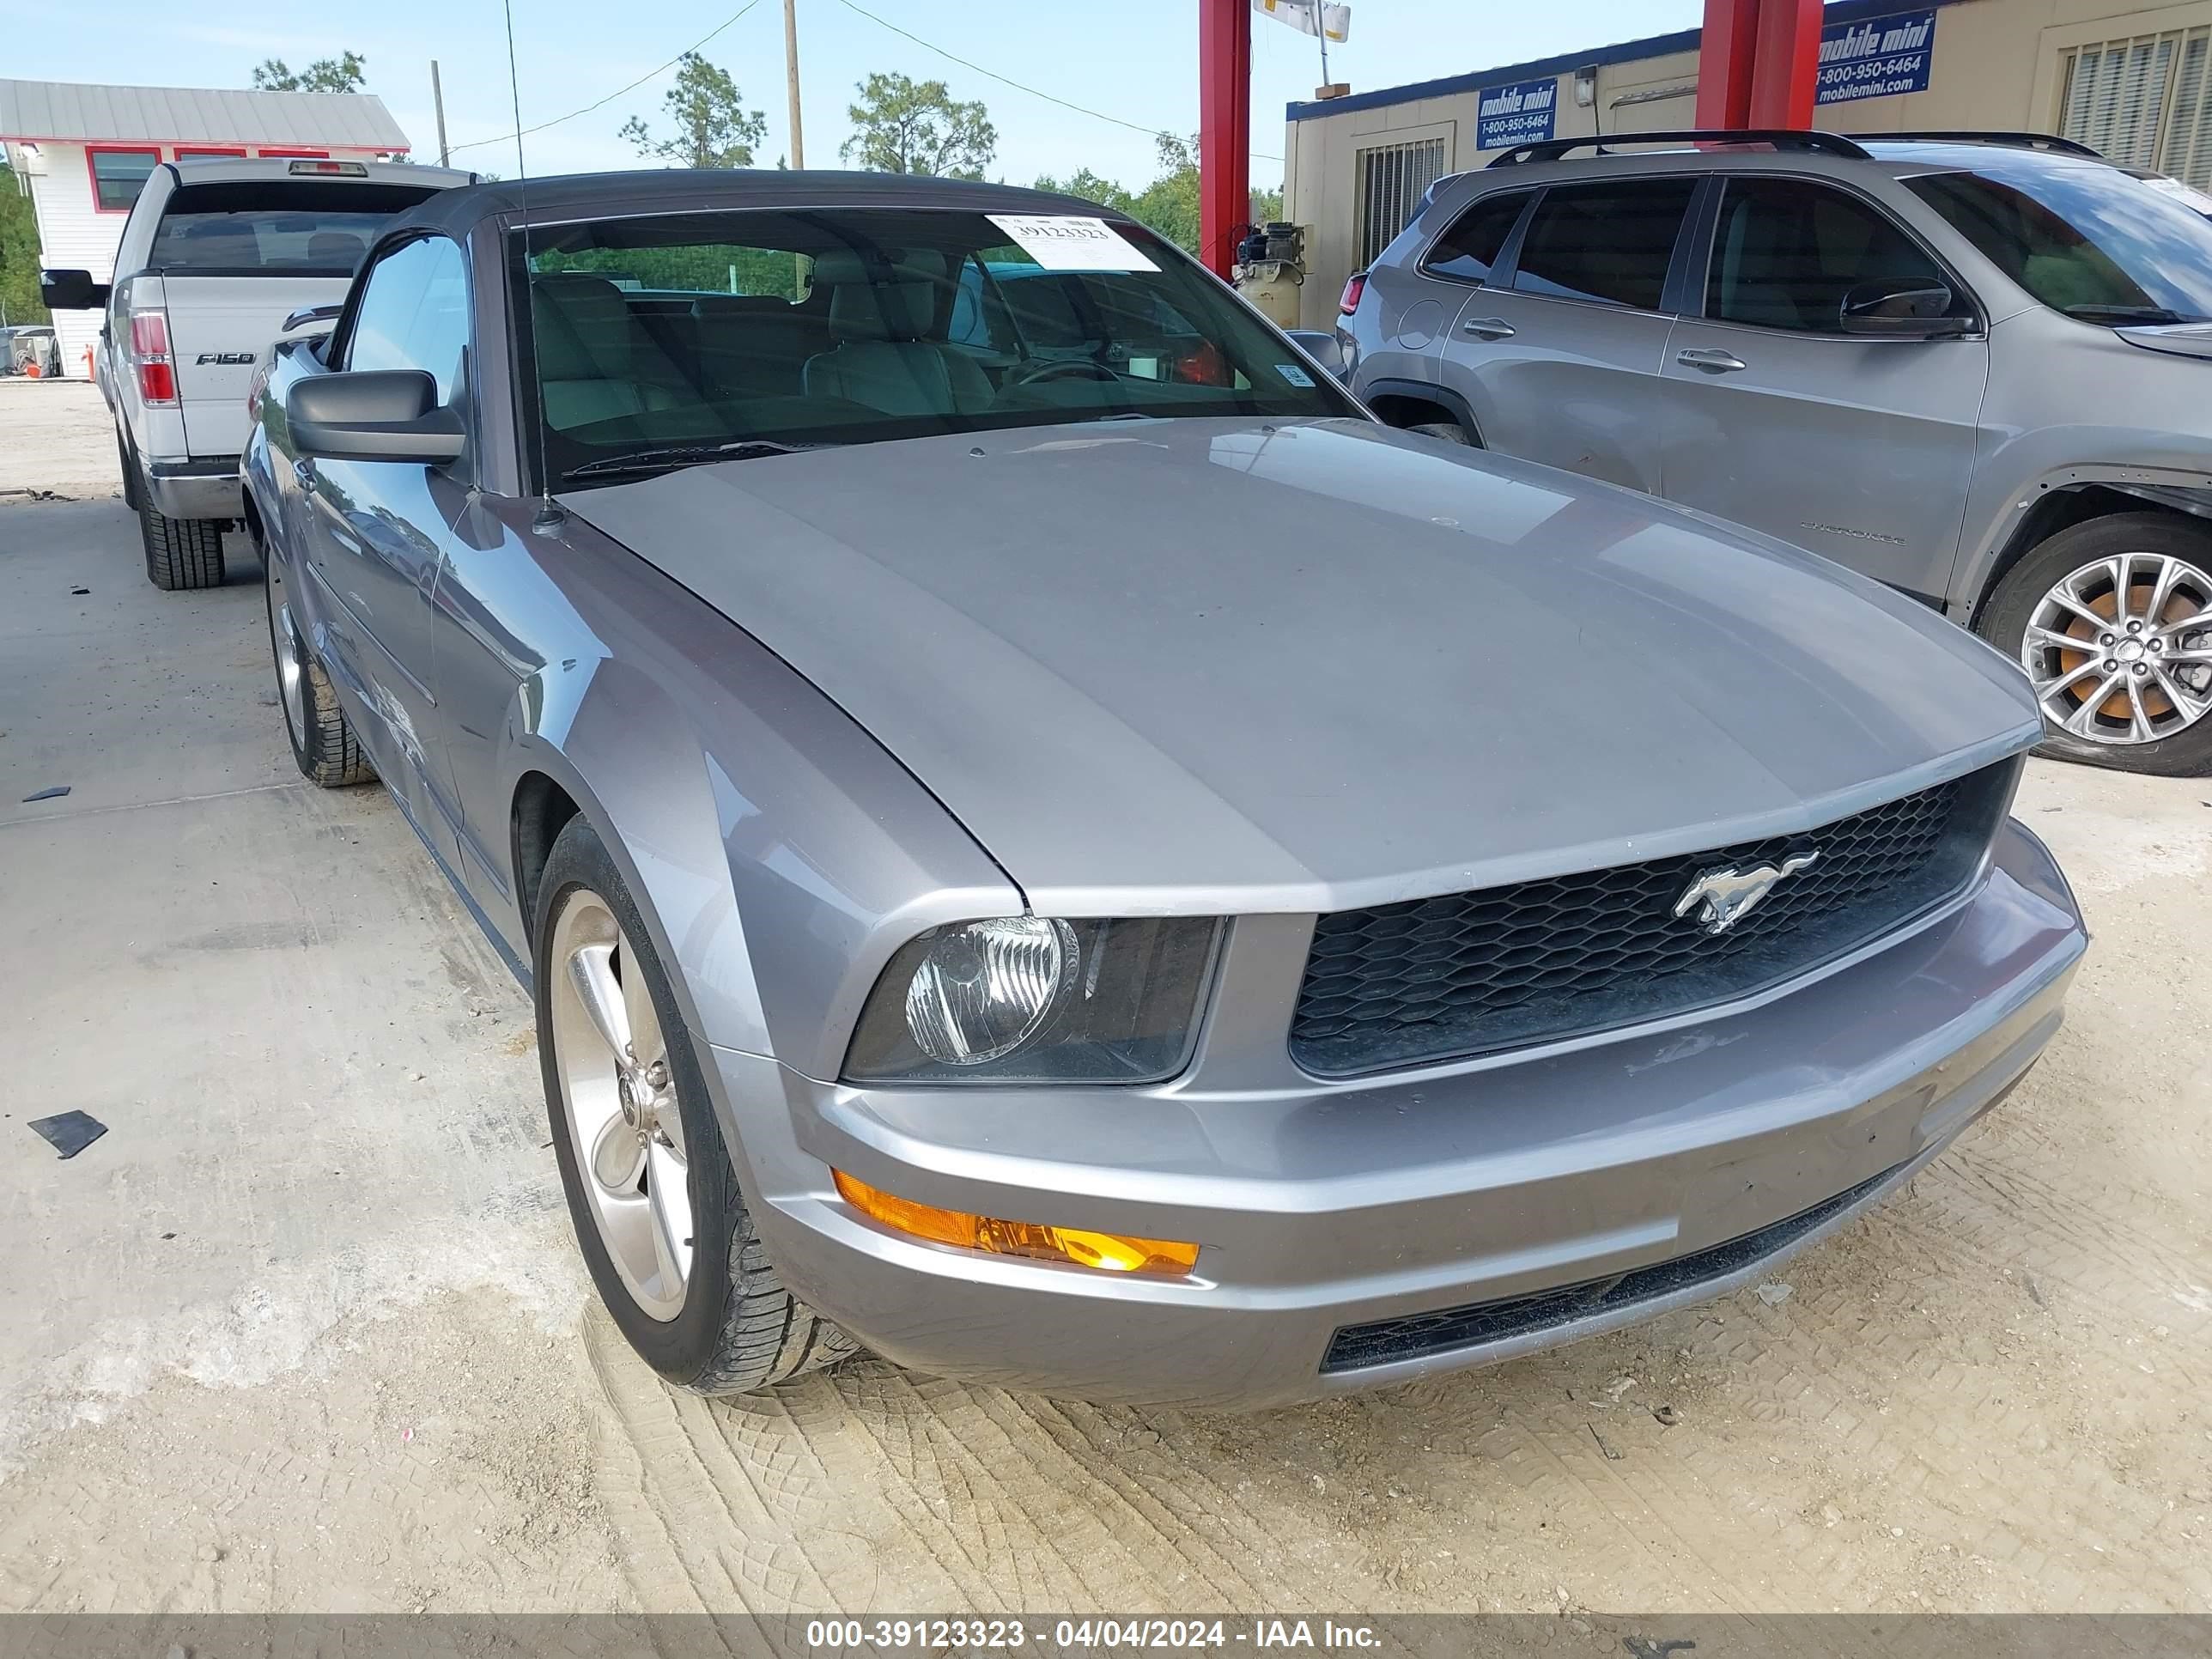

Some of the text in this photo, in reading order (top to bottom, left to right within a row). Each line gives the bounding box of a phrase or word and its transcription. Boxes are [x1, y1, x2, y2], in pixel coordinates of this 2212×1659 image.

[1819, 18, 1931, 63] mobile mini
[1815, 55, 1922, 86] 1-800-950-6464
[1480, 85, 1554, 117] mobile mini
[1819, 78, 1913, 102] mobilemini.com
[1482, 113, 1549, 134] 1-800-950-6464
[1485, 131, 1544, 148] mobilemini.com
[1014, 226, 1109, 239] 39123323
[195, 353, 256, 365] F-150
[1801, 521, 1908, 546] CHEROKEE
